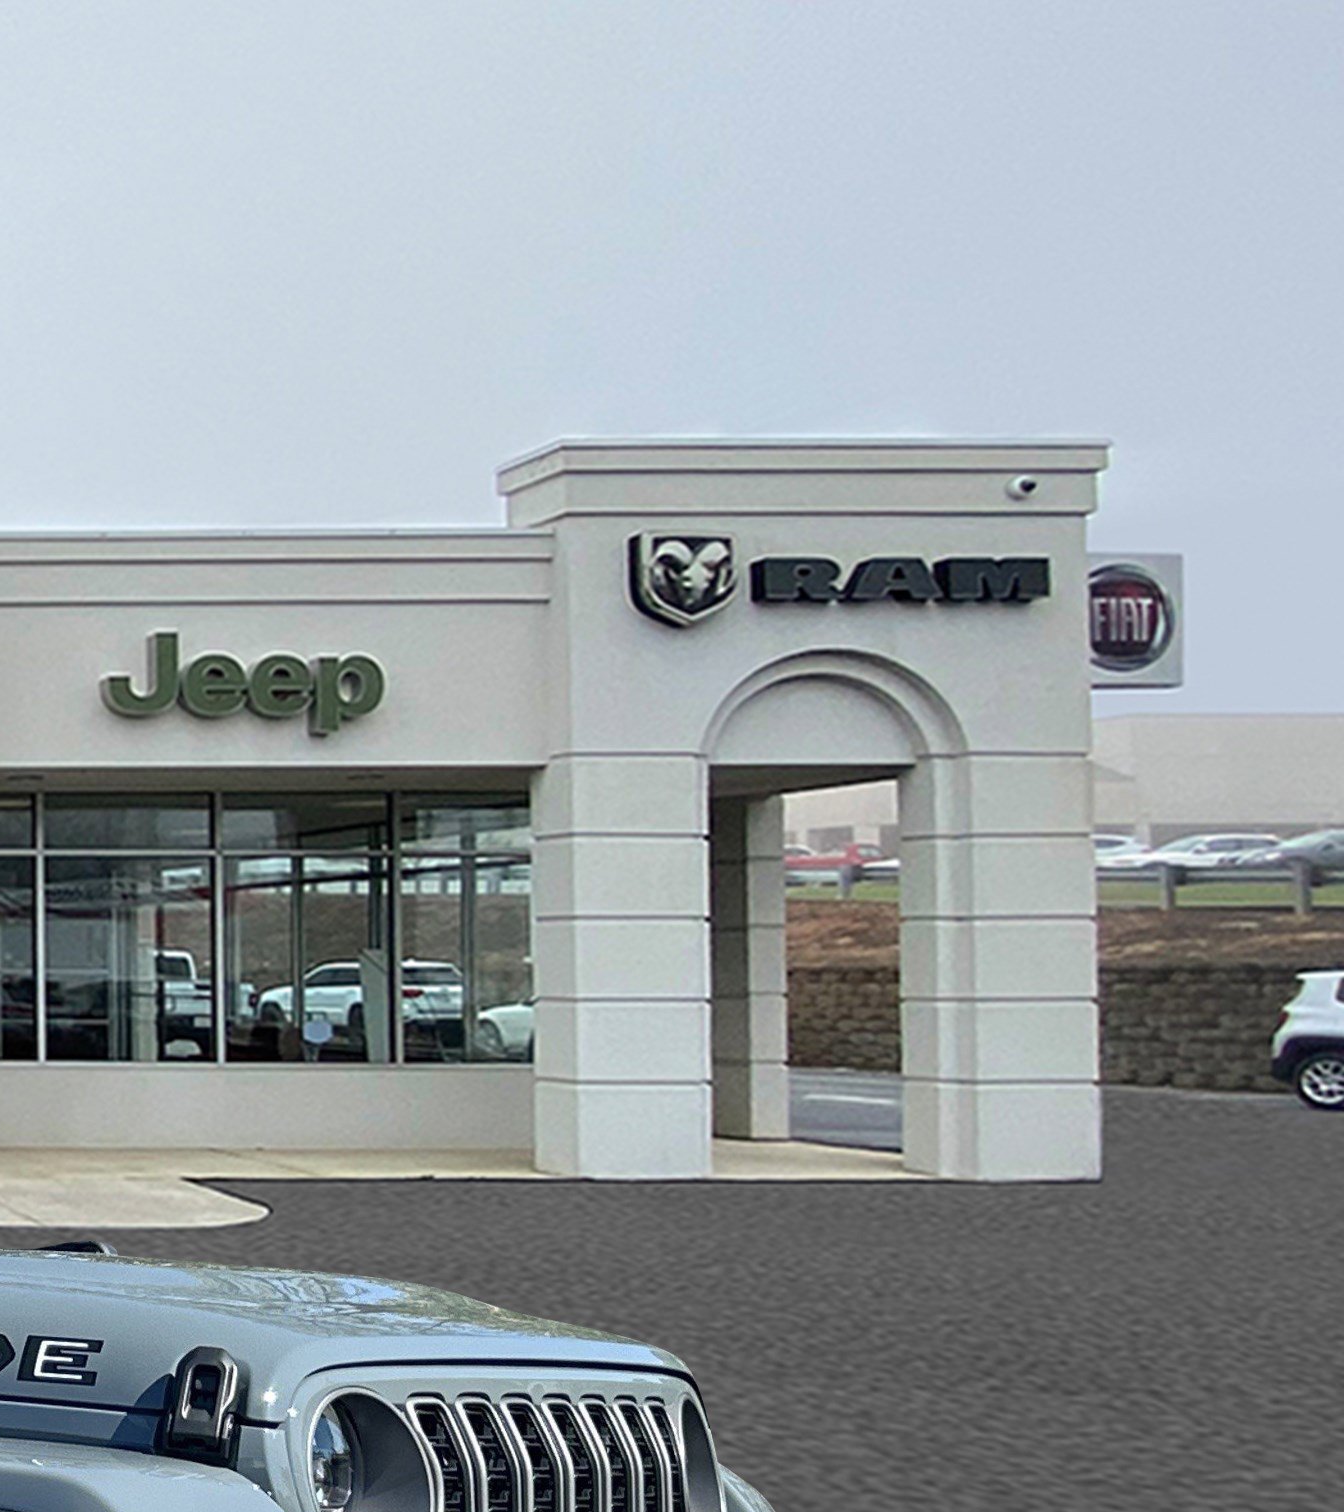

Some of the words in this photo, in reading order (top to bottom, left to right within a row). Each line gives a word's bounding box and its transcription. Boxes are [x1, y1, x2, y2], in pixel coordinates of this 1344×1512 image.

[749, 556, 1051, 604] RAM
[1092, 597, 1153, 642] FIAT
[99, 628, 386, 737] Jeep
